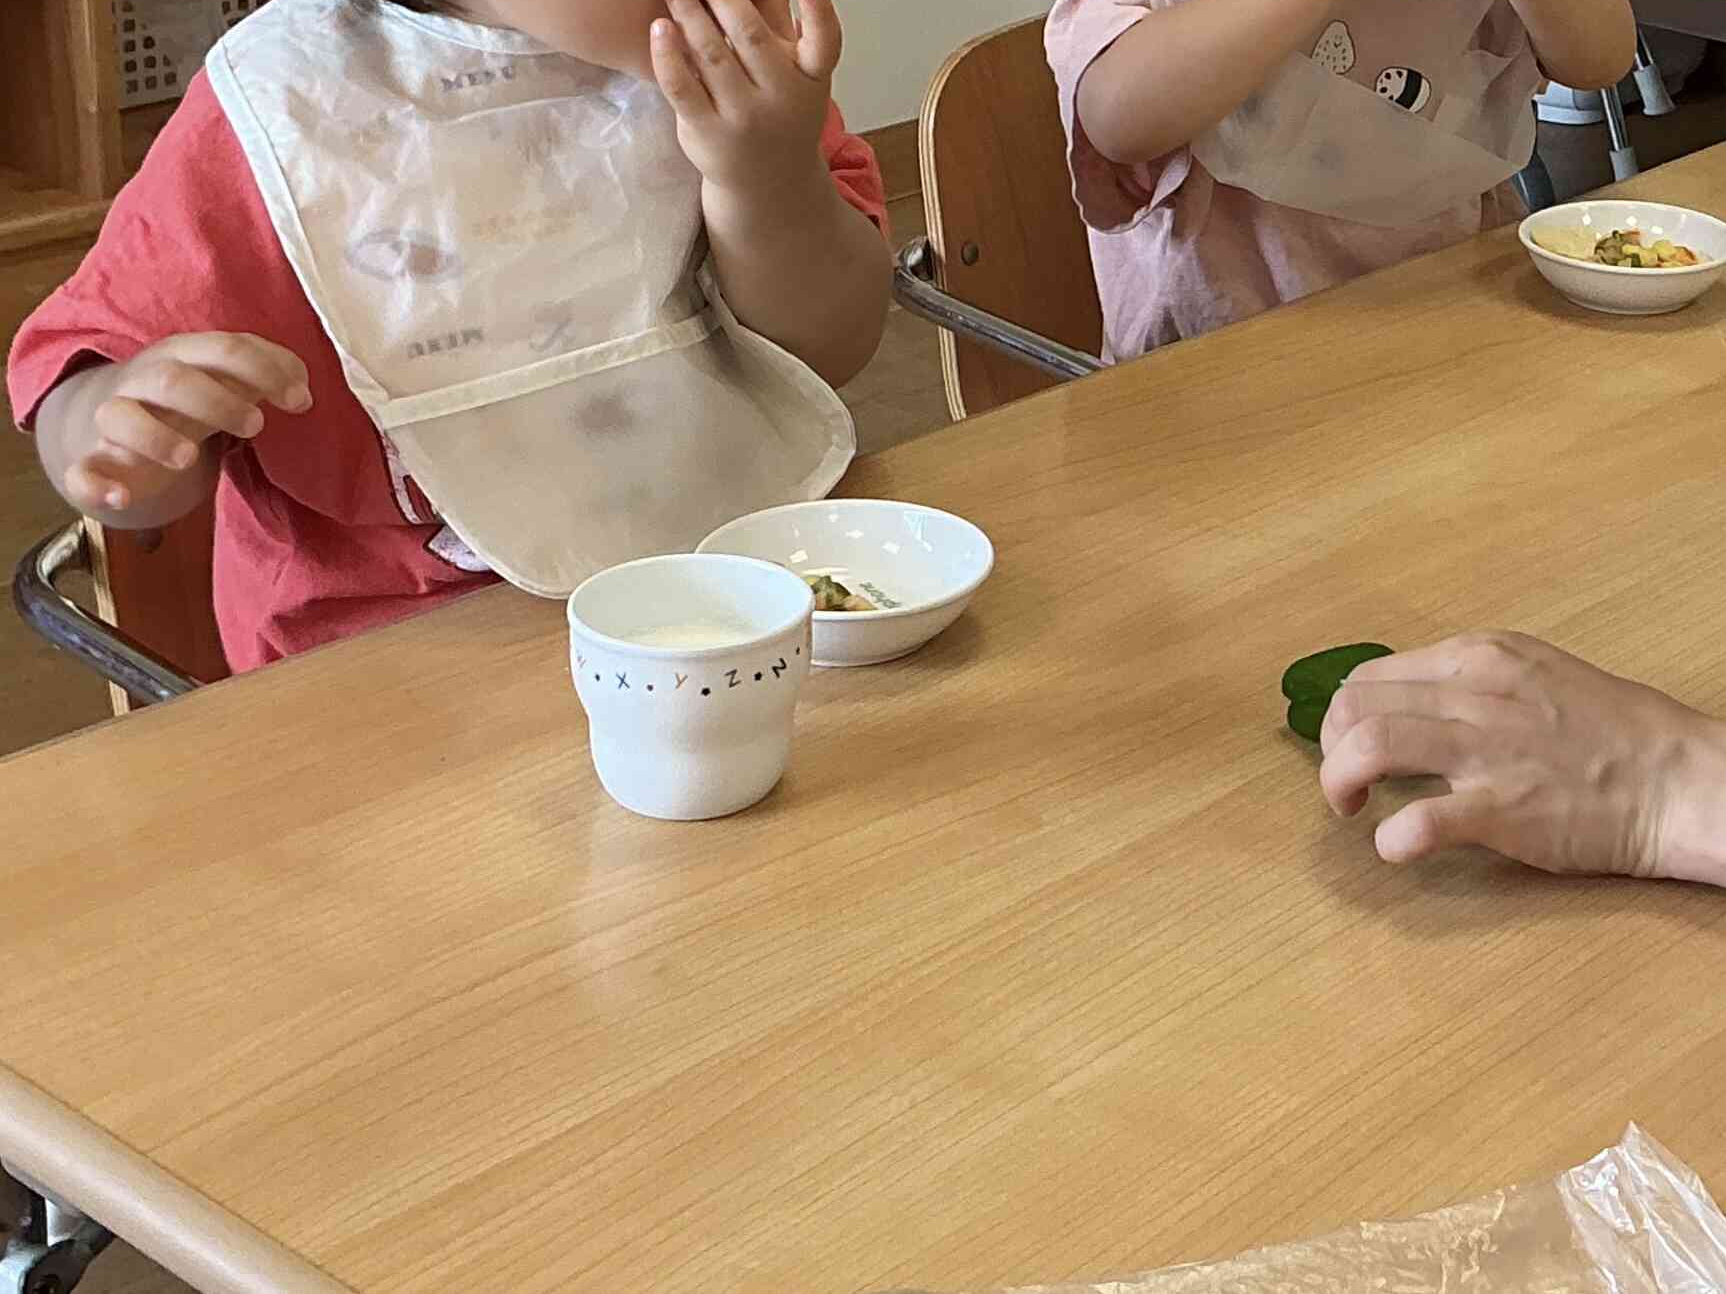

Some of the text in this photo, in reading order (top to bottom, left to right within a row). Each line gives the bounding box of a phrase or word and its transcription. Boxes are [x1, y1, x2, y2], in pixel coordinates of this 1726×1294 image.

[616, 672, 631, 689] X
[674, 673, 689, 689] Y
[725, 669, 741, 688] Z
